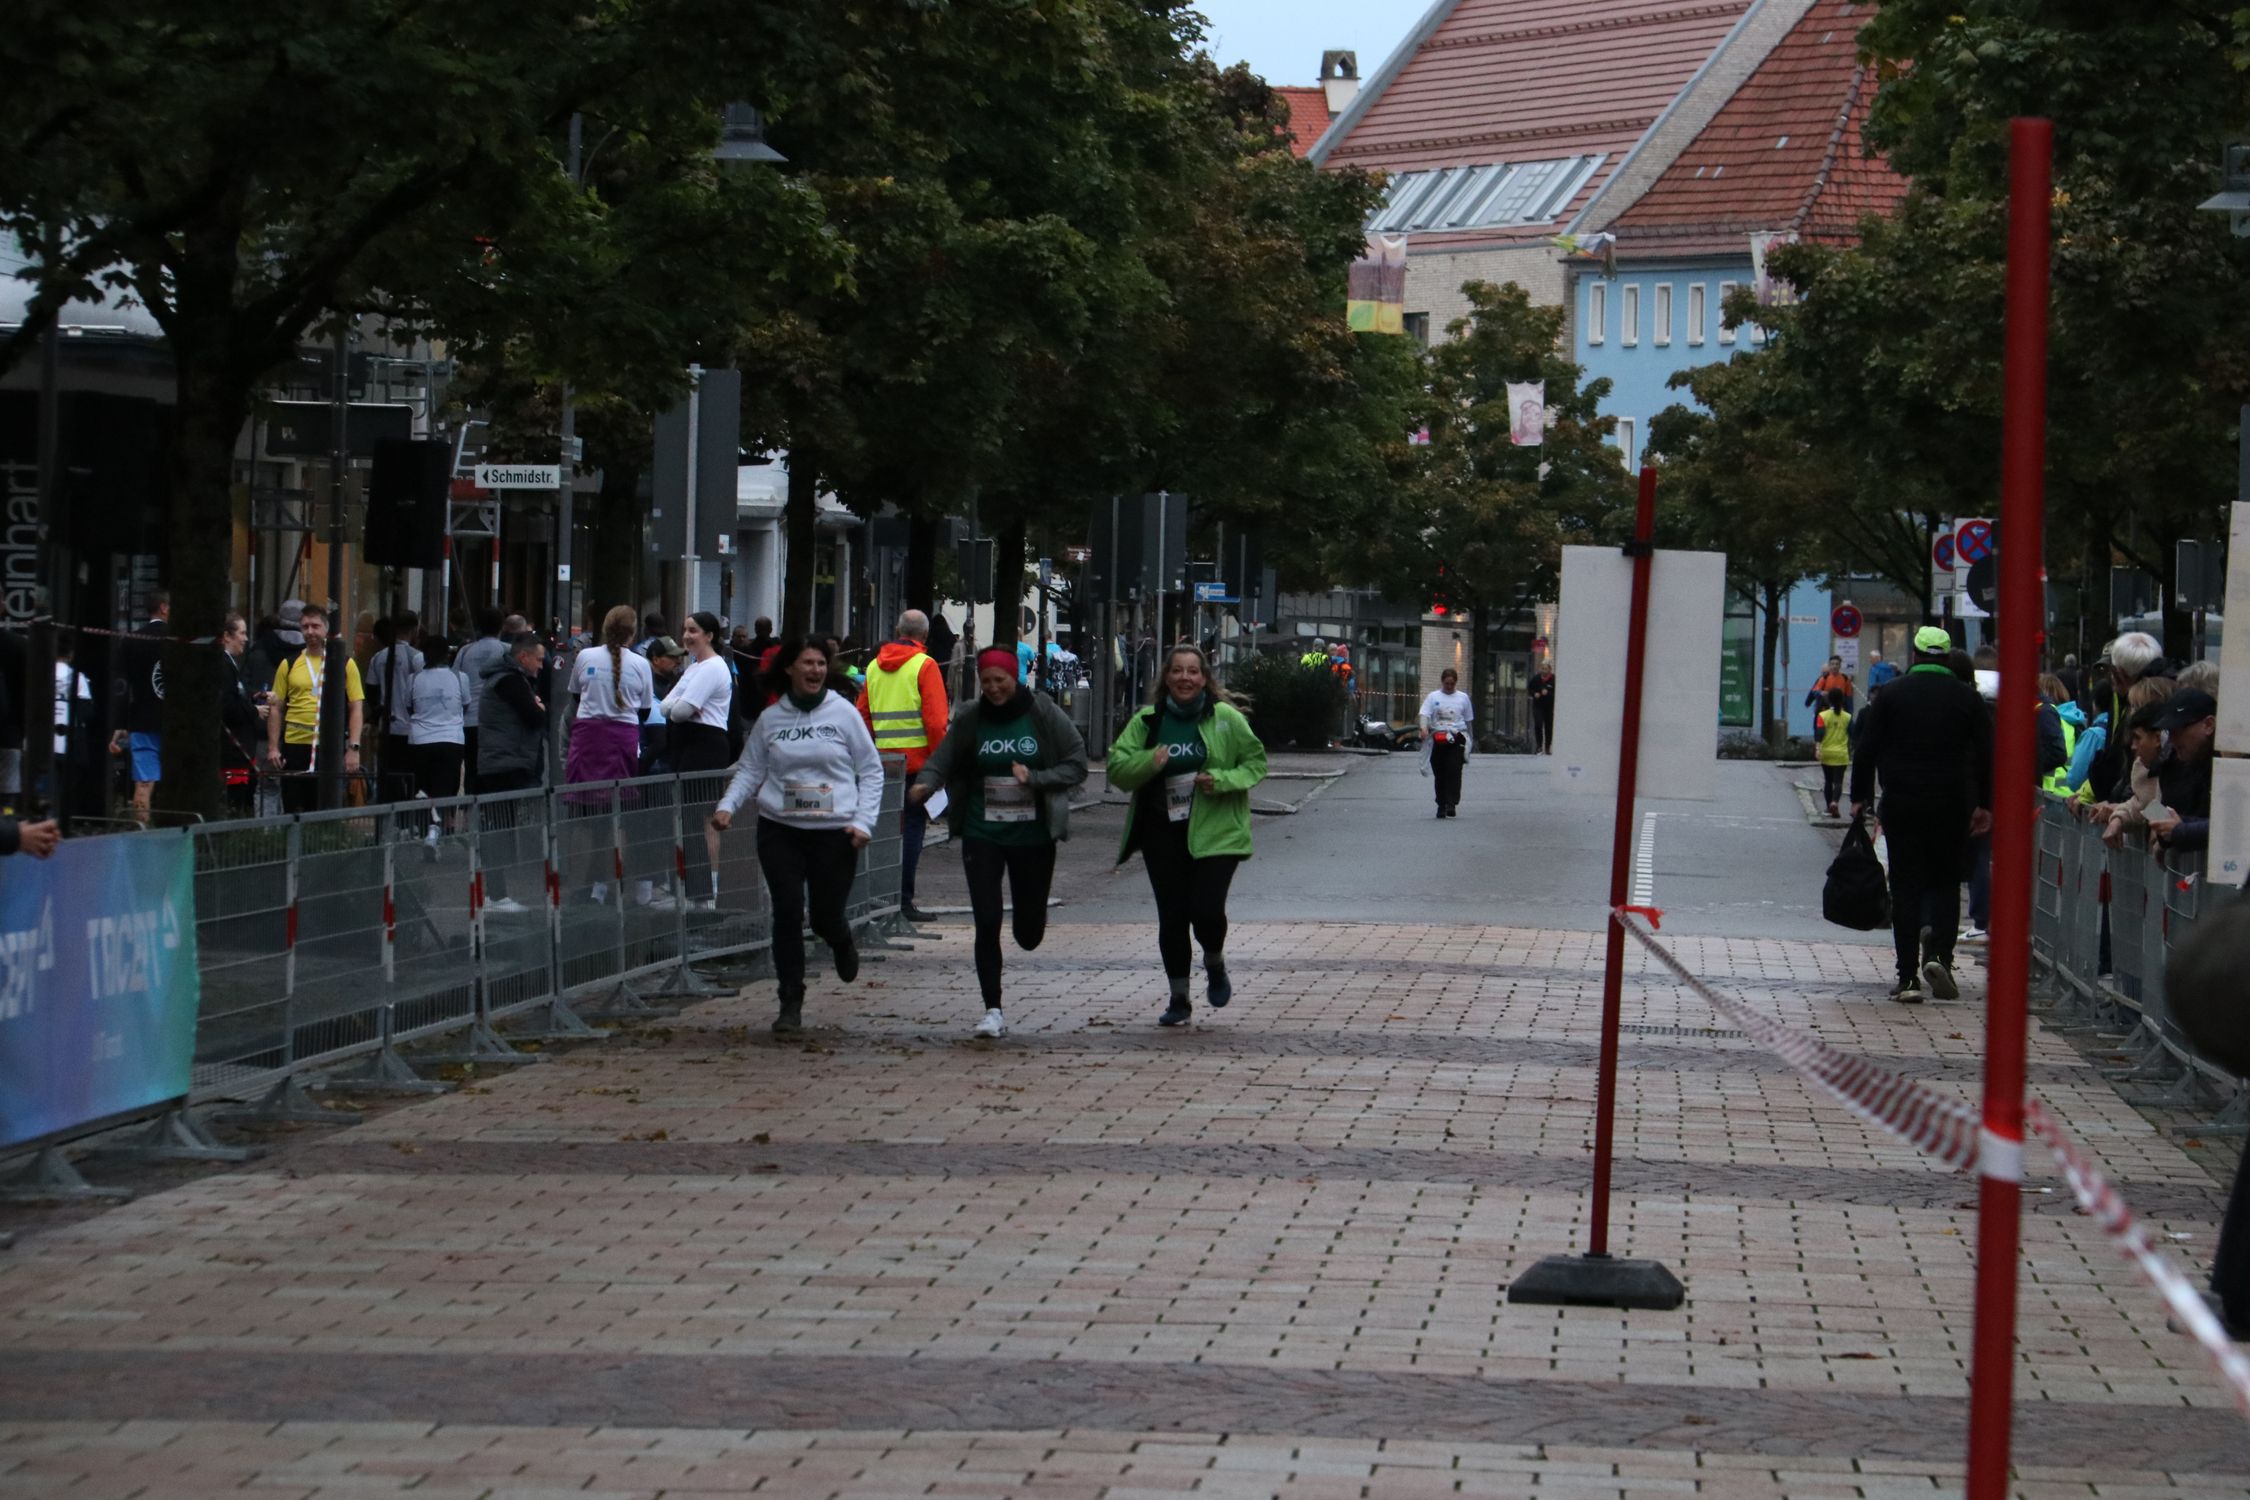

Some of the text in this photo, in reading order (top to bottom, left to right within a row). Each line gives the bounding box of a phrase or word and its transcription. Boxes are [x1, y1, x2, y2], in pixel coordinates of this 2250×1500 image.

[491, 469, 554, 484] Schmidstr.
[774, 726, 814, 741] AOK
[977, 739, 1017, 755] AOK
[1167, 742, 1194, 757] OK
[794, 798, 820, 809] Nora
